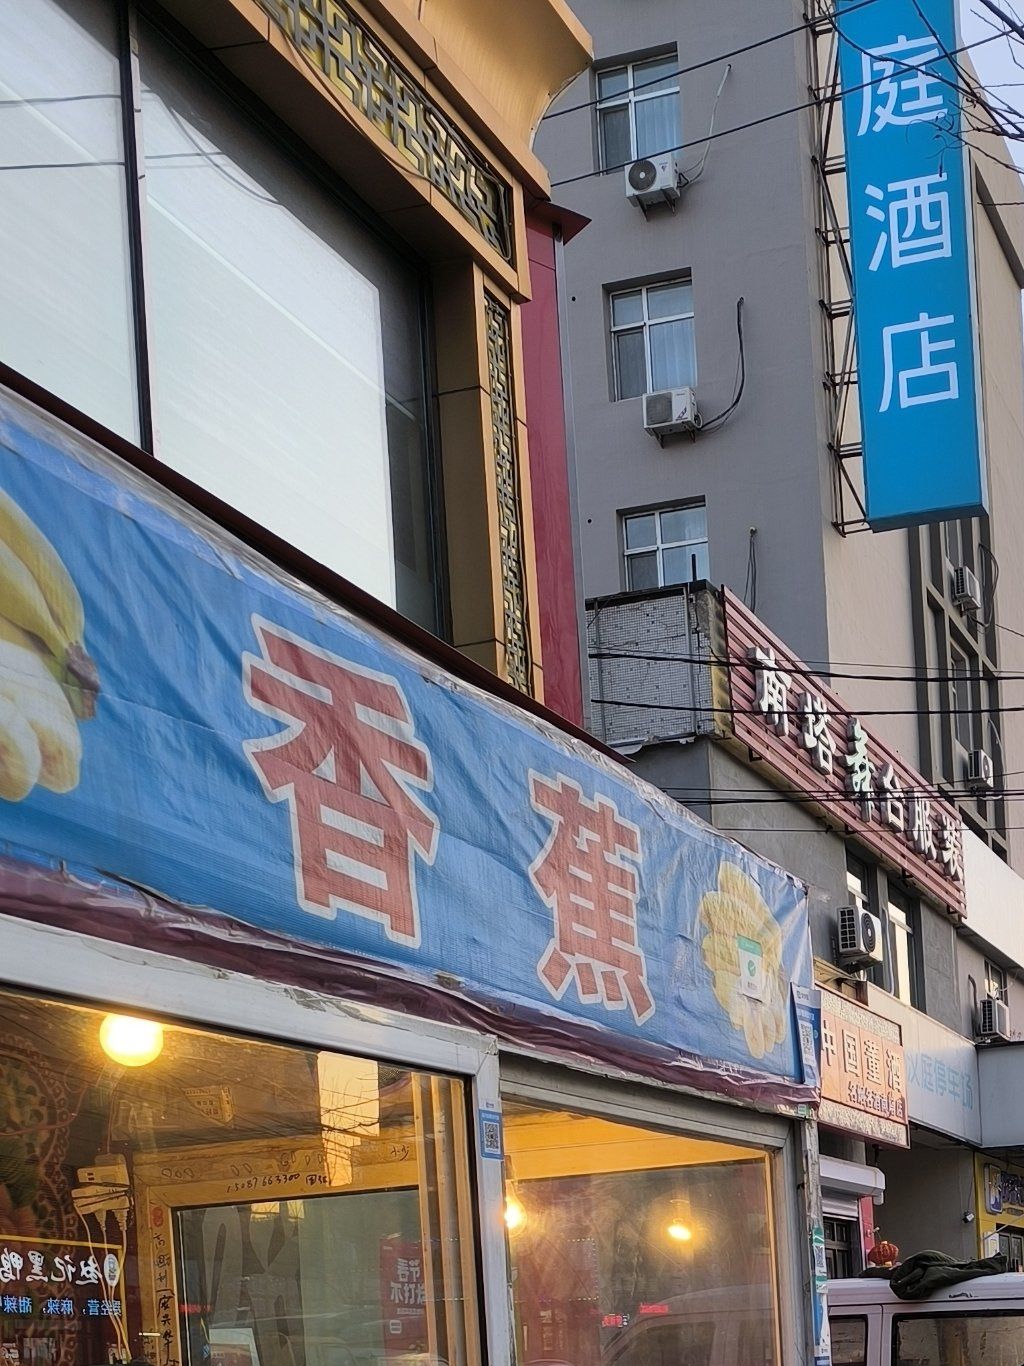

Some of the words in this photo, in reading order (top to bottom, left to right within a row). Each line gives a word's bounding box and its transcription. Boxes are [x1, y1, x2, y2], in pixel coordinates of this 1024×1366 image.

[857, 34, 959, 413] 庭酒店
[242, 613, 656, 1025] 香蕉
[821, 1019, 902, 1093] 中国董酒
